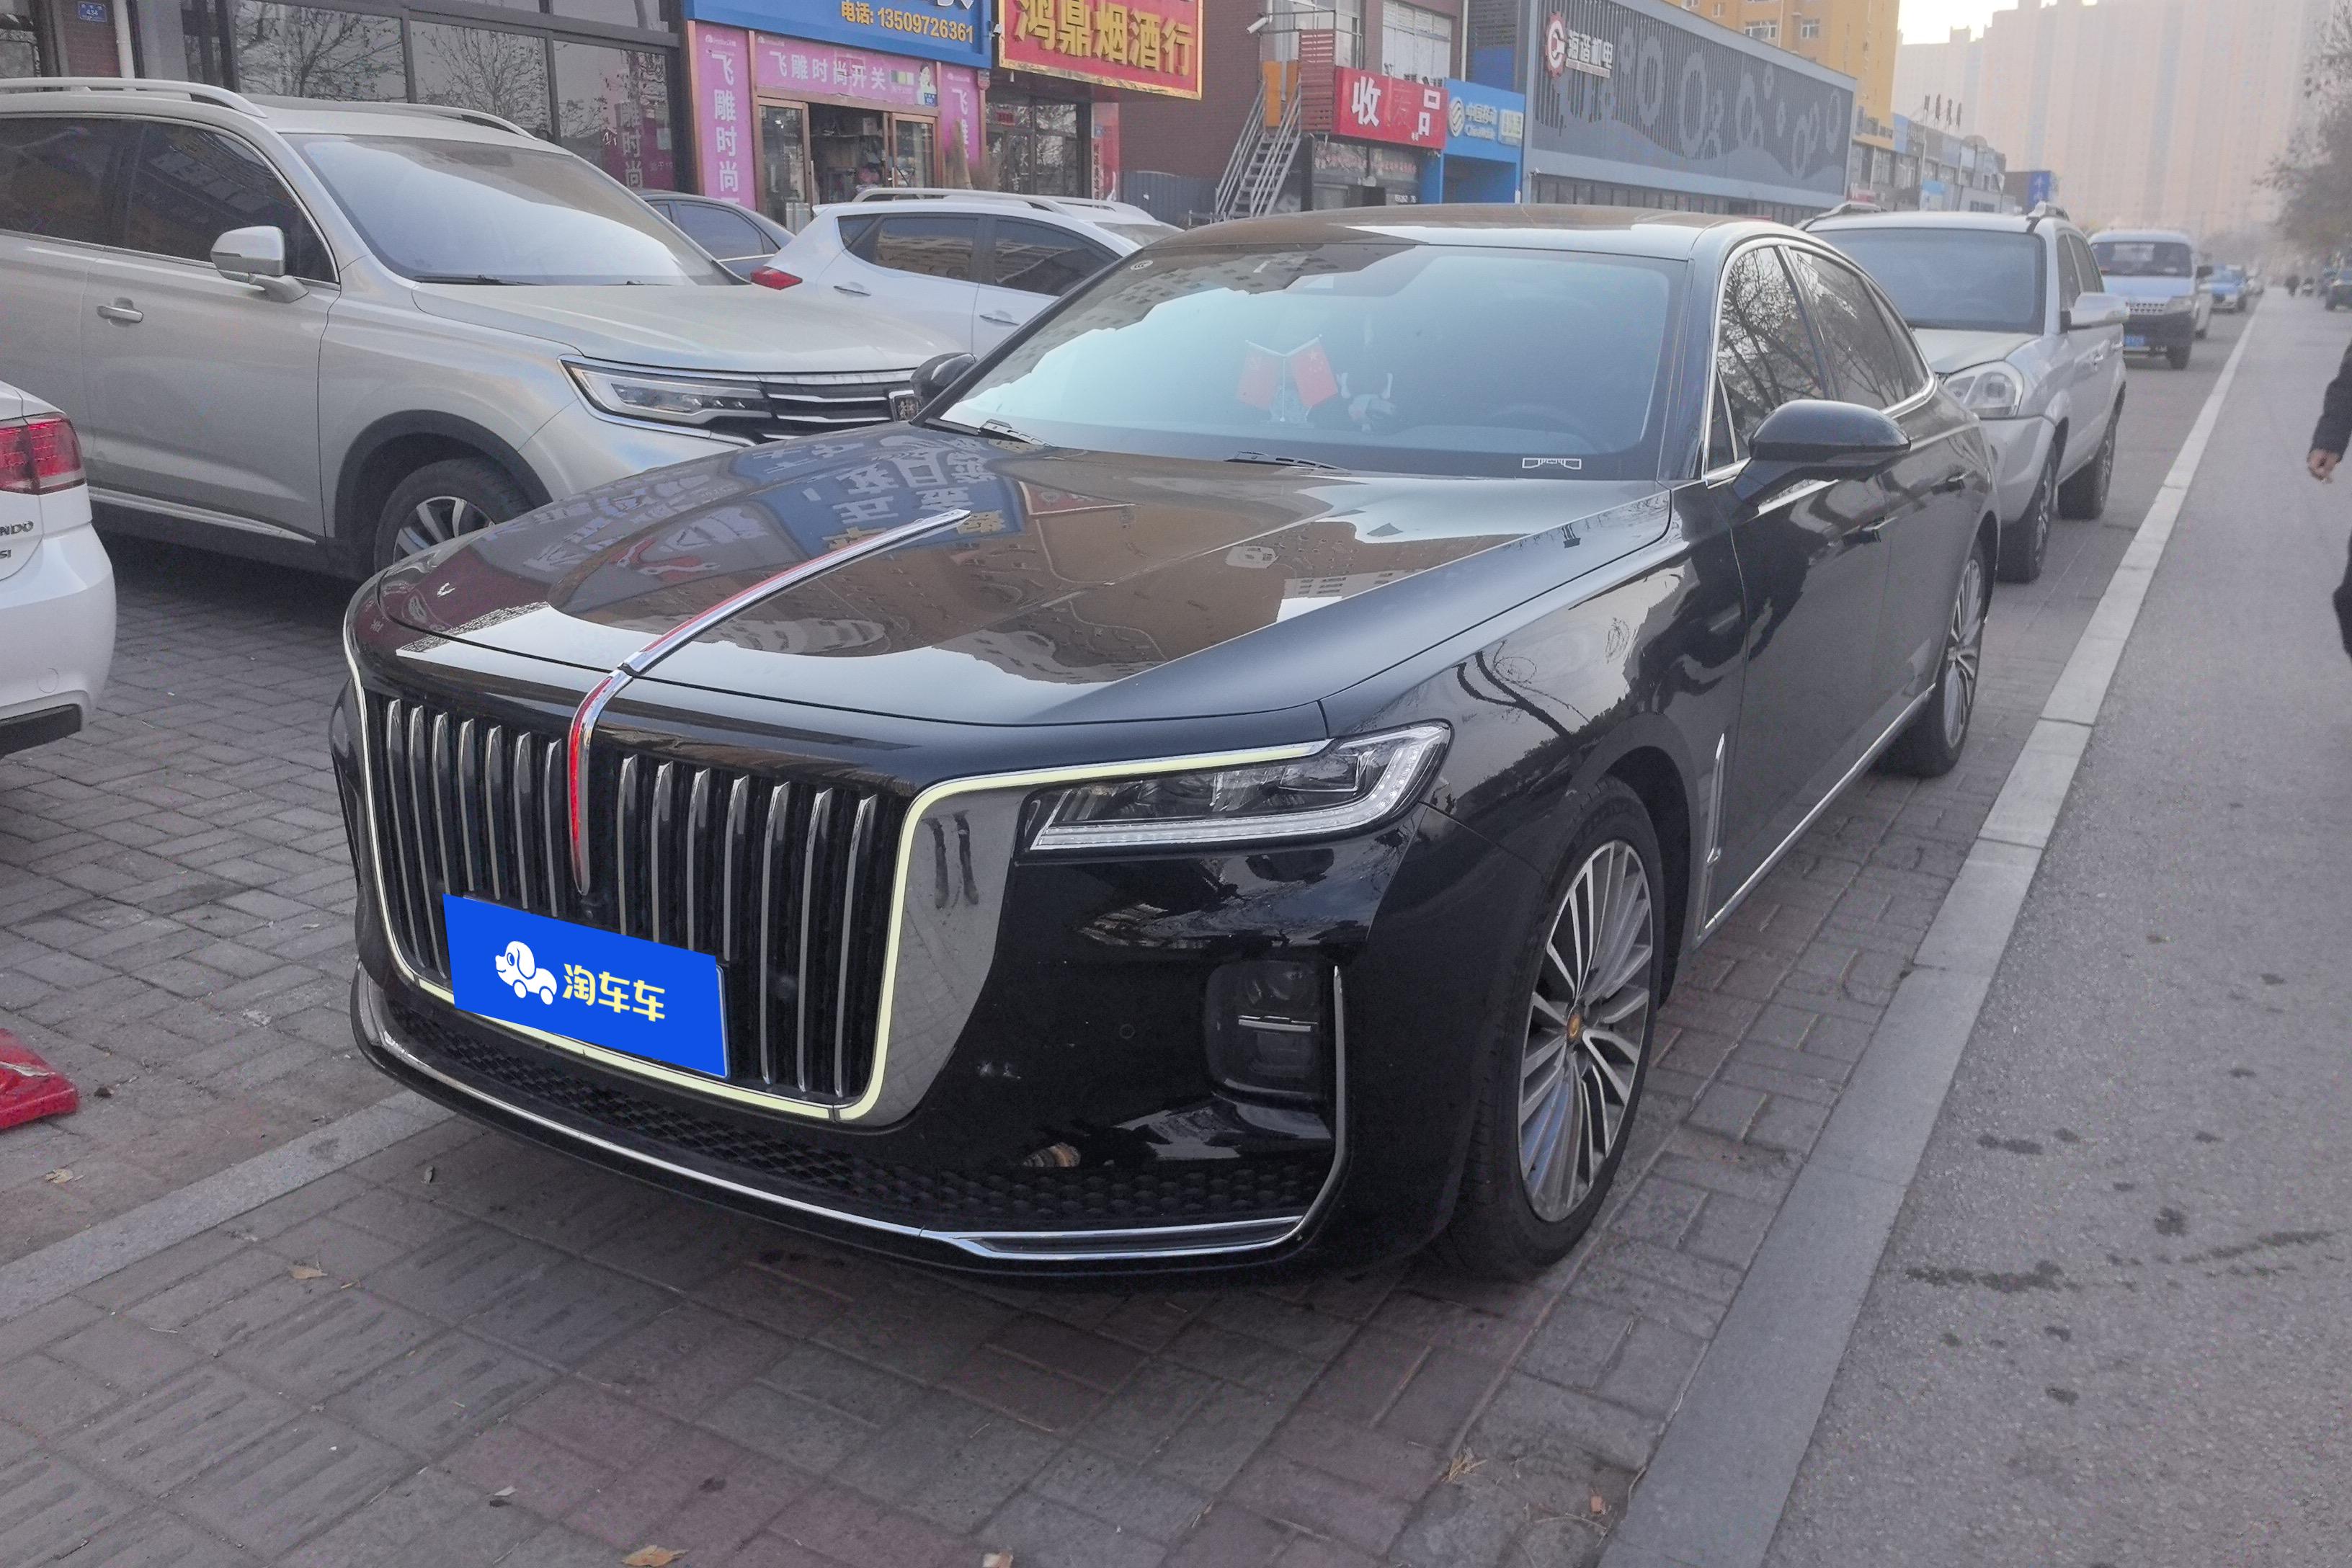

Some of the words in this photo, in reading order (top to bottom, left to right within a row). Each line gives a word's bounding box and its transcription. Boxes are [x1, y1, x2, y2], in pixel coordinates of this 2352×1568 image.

[841, 0, 873, 25] 电话:
[878, 7, 974, 44] 13509726361
[1014, 0, 1194, 76] 鸿鼎烟酒行
[769, 50, 886, 92] 飞雕时尚开关
[711, 53, 740, 205] 飞雕时尚
